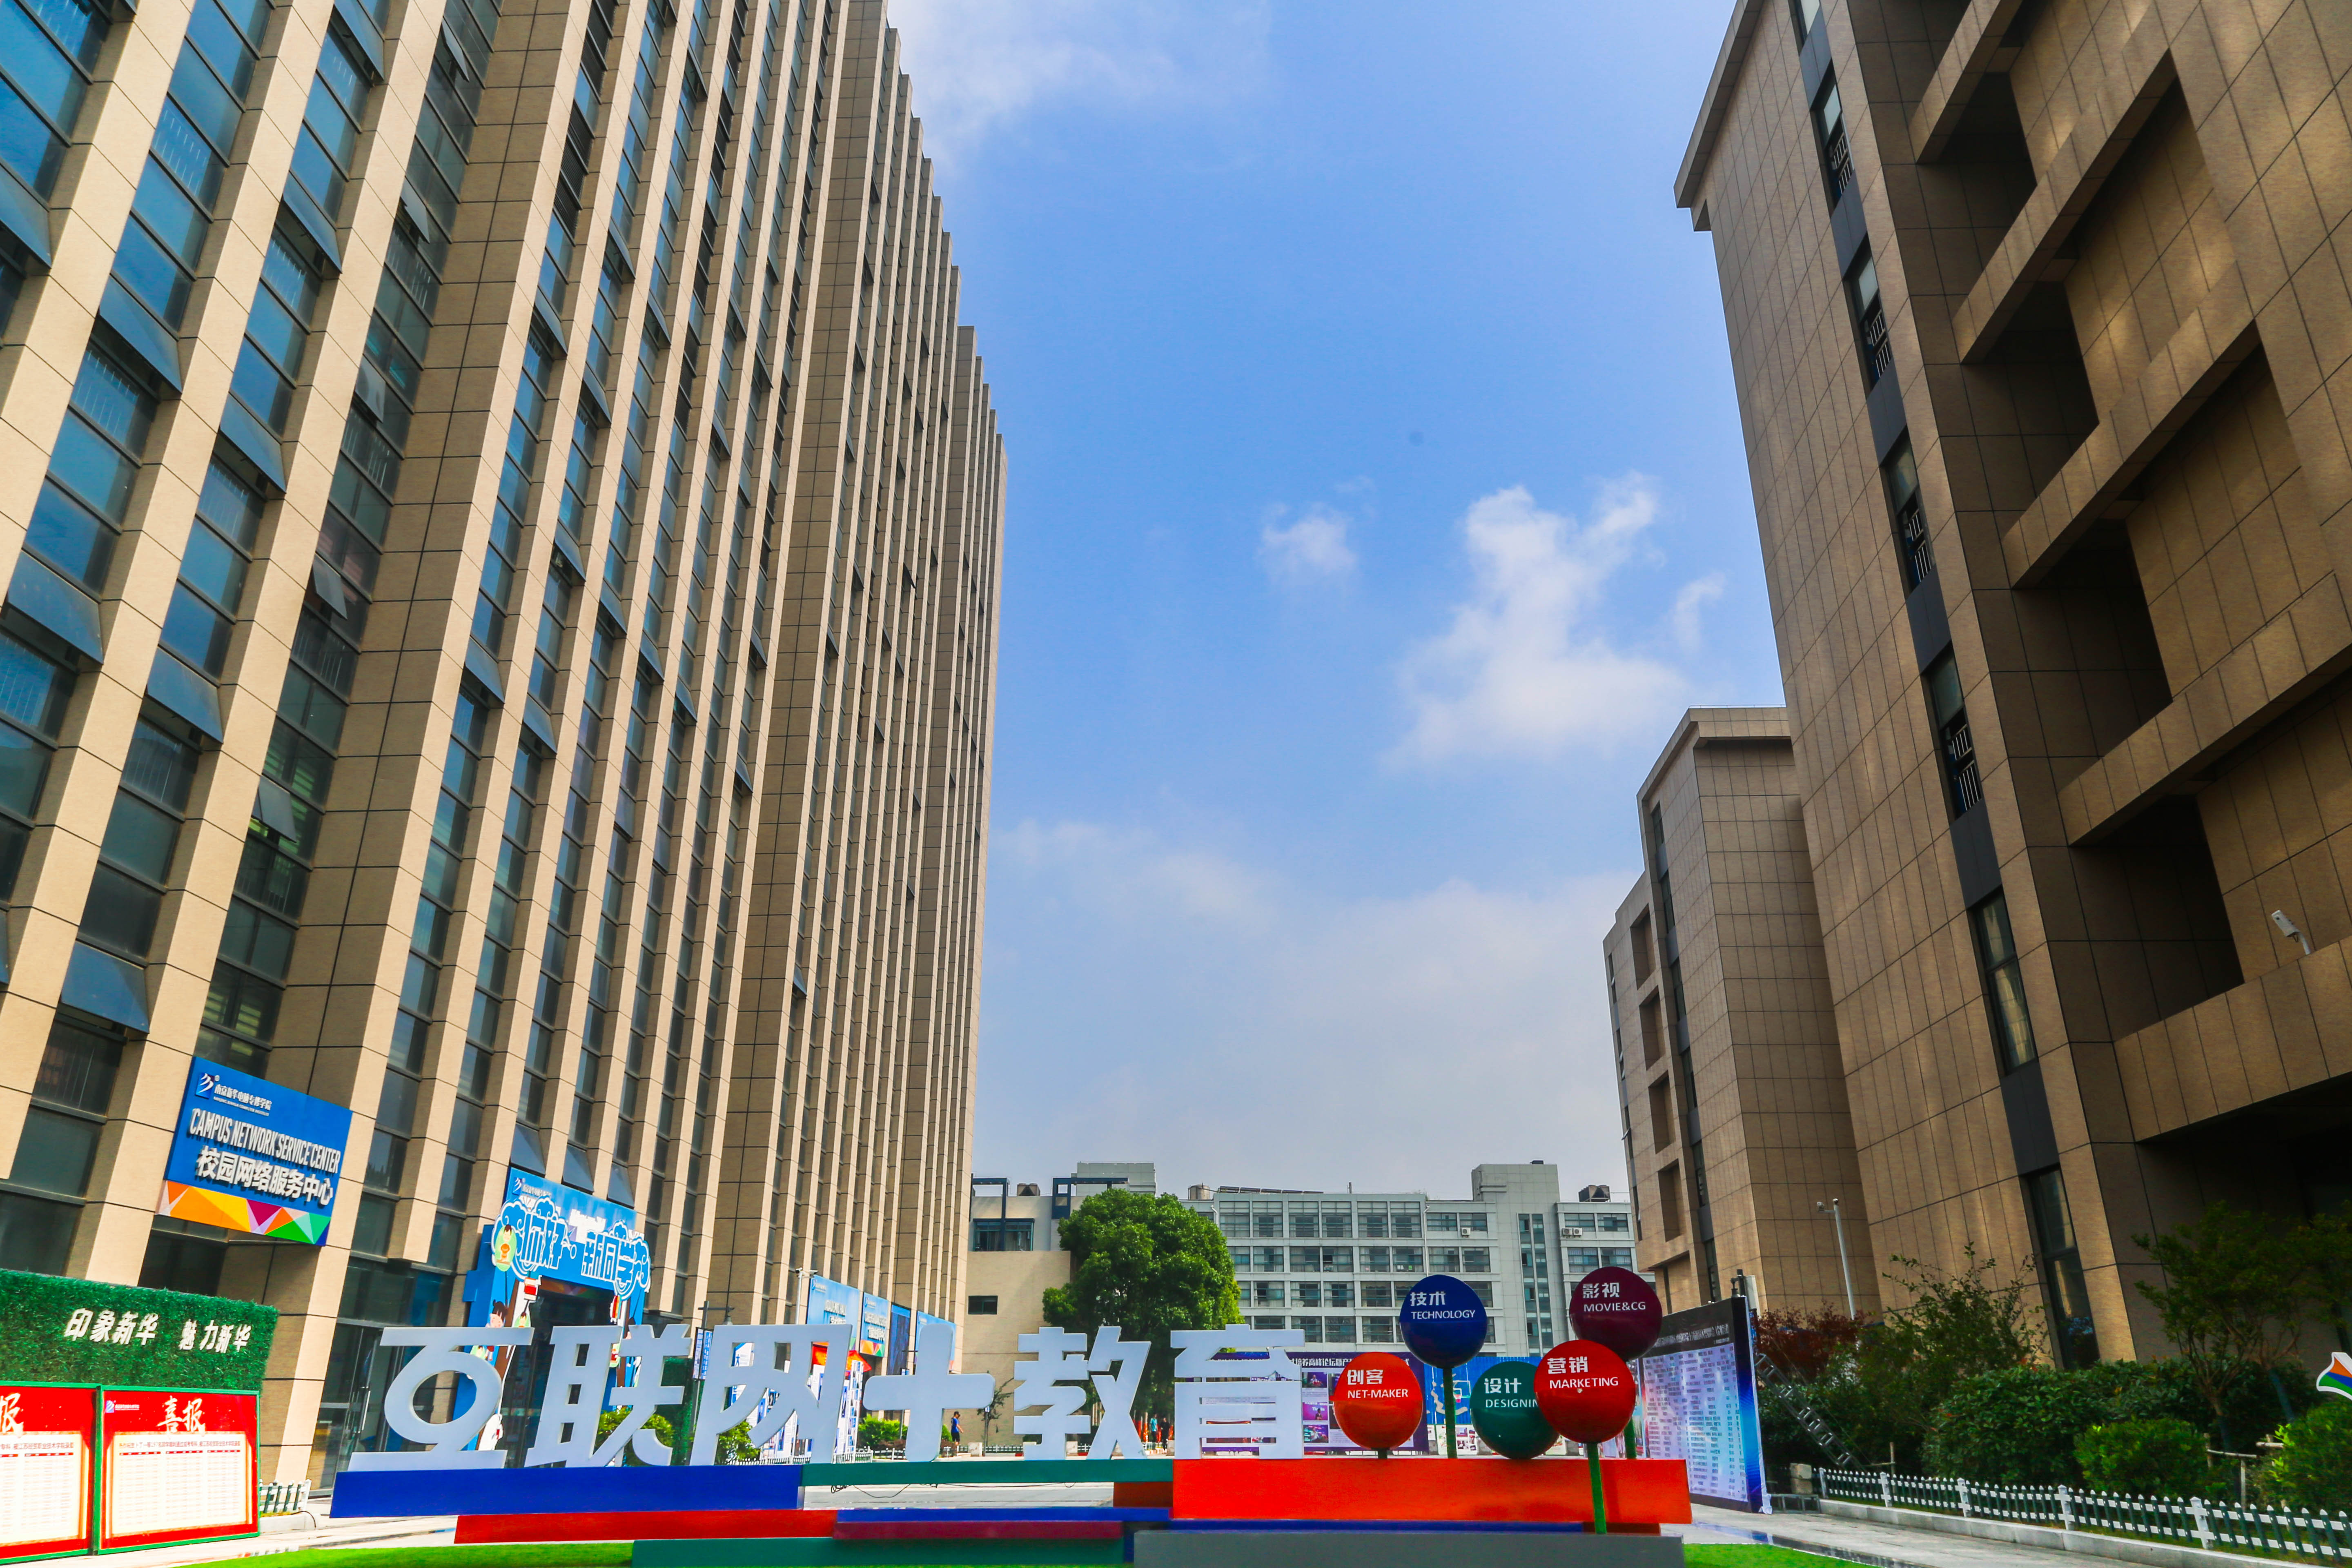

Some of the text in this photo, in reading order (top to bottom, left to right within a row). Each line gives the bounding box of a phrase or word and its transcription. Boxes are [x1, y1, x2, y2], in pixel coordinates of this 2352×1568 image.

[190, 1108, 341, 1173] CAMPUS NETWORK SERVICE CENTER
[196, 1145, 333, 1205] 校园网络服务中心
[1583, 1283, 1620, 1298] 影视
[1410, 1292, 1446, 1306] 技术
[1584, 1302, 1646, 1312] MOVIE&CG
[1411, 1310, 1475, 1319] TECHNOLOGY
[64, 1308, 252, 1353] 印象新华 魅力新华
[1547, 1356, 1588, 1374] 营销
[1347, 1369, 1383, 1385] 创客
[1549, 1377, 1619, 1389] MARKETING
[1348, 1389, 1408, 1398] NET-MAKER
[1484, 1378, 1521, 1394] 设计
[157, 1395, 206, 1434] 喜报
